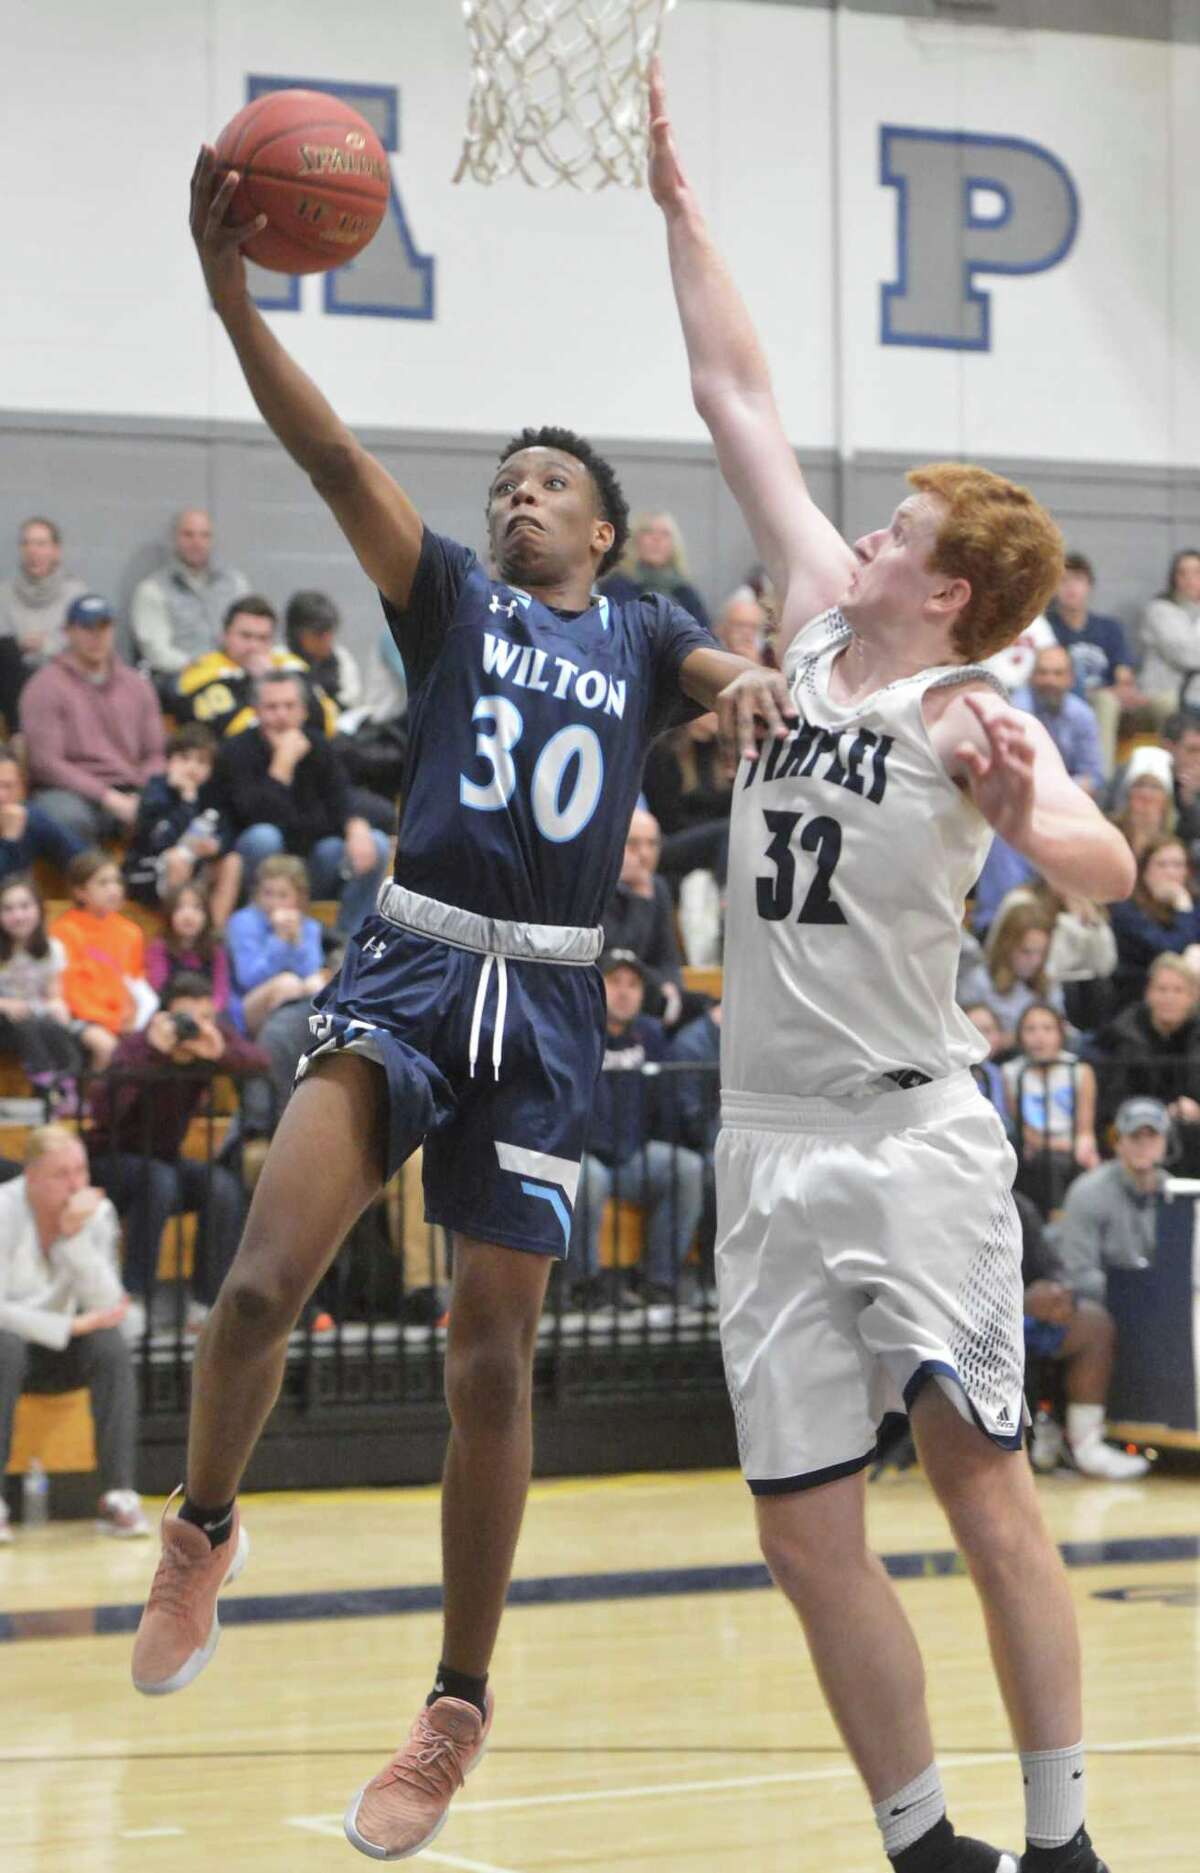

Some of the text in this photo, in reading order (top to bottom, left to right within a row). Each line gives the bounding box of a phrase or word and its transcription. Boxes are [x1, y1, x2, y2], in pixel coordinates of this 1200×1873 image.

[879, 124, 1079, 351] P
[482, 632, 627, 721] WILTON
[459, 694, 605, 844] 30
[755, 809, 849, 925] 32
